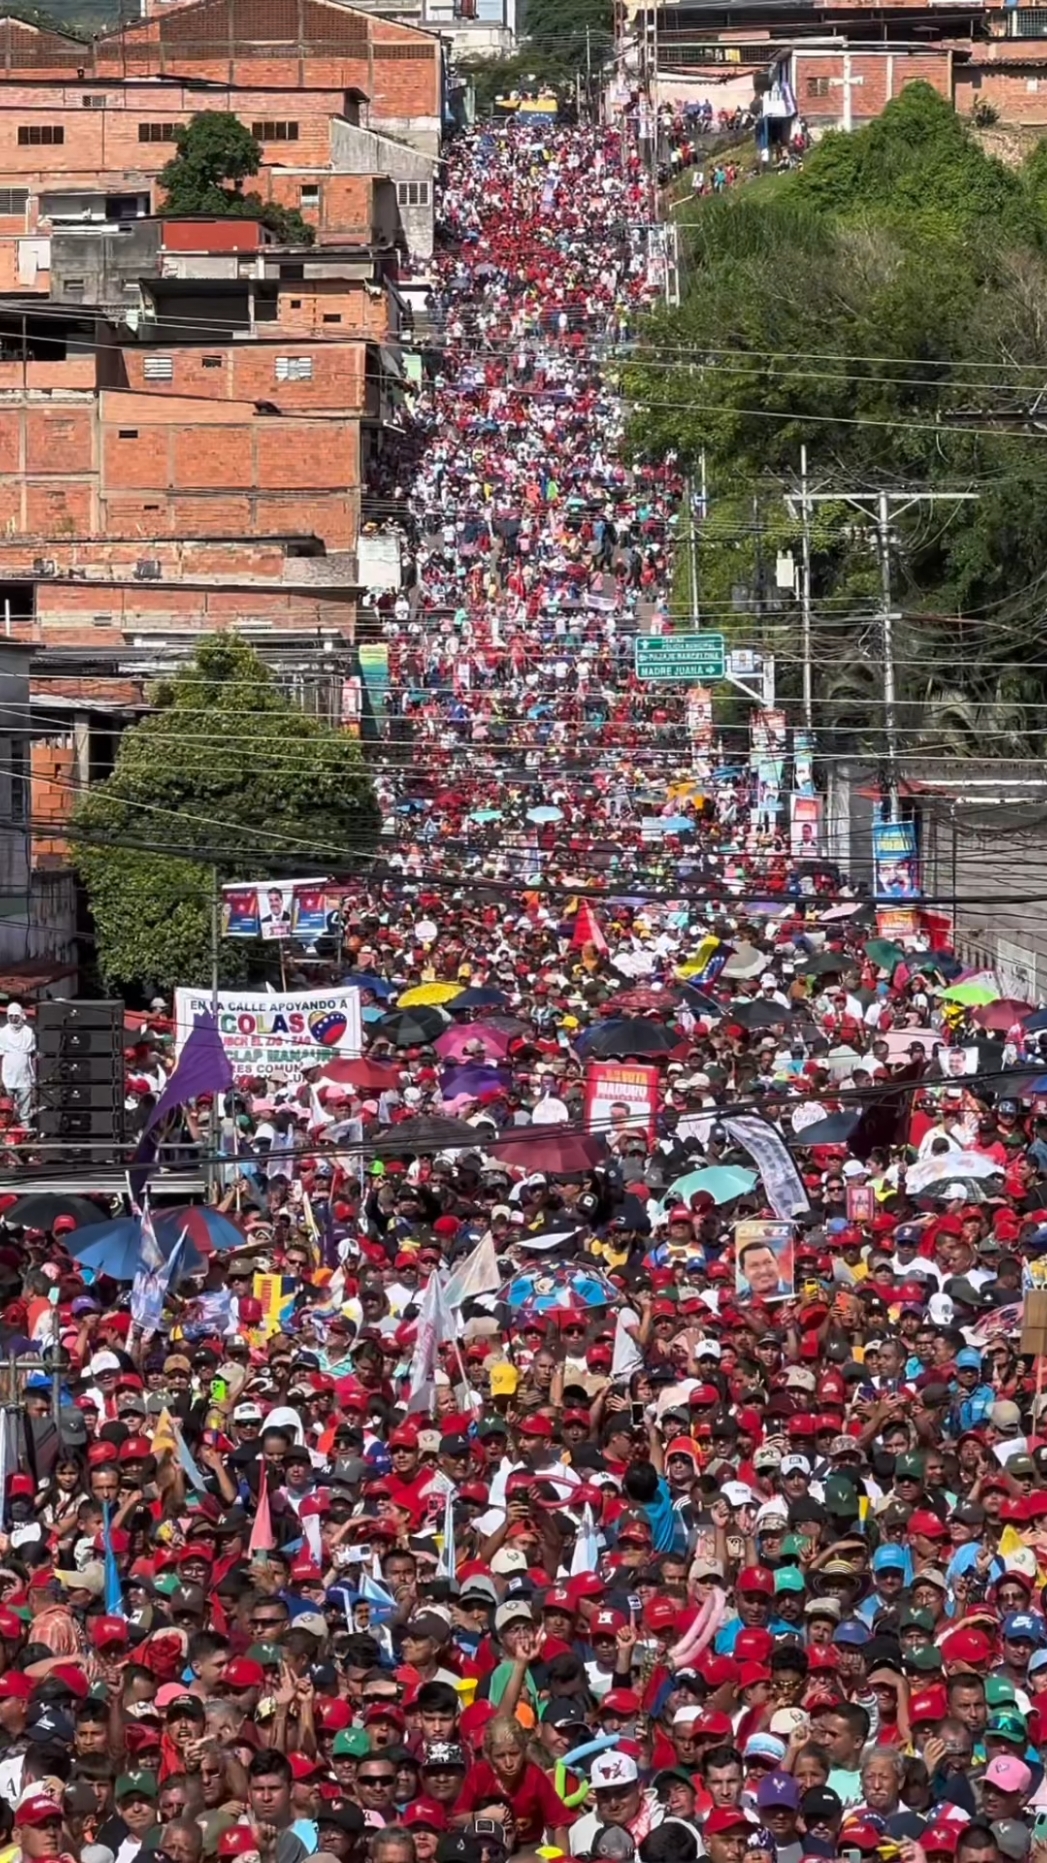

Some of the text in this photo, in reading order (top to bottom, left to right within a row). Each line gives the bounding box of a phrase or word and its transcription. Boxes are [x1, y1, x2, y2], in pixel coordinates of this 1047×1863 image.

[640, 665, 704, 676] MADRE JUANA
[190, 1000, 206, 1010] EN
[228, 1002, 266, 1012] CALLE
[270, 1000, 336, 1012] APOYANDO
[340, 999, 348, 1009] A
[221, 1013, 305, 1034] COLAS
[226, 1049, 263, 1063] CLAP
[256, 1064, 302, 1073] COMUN
